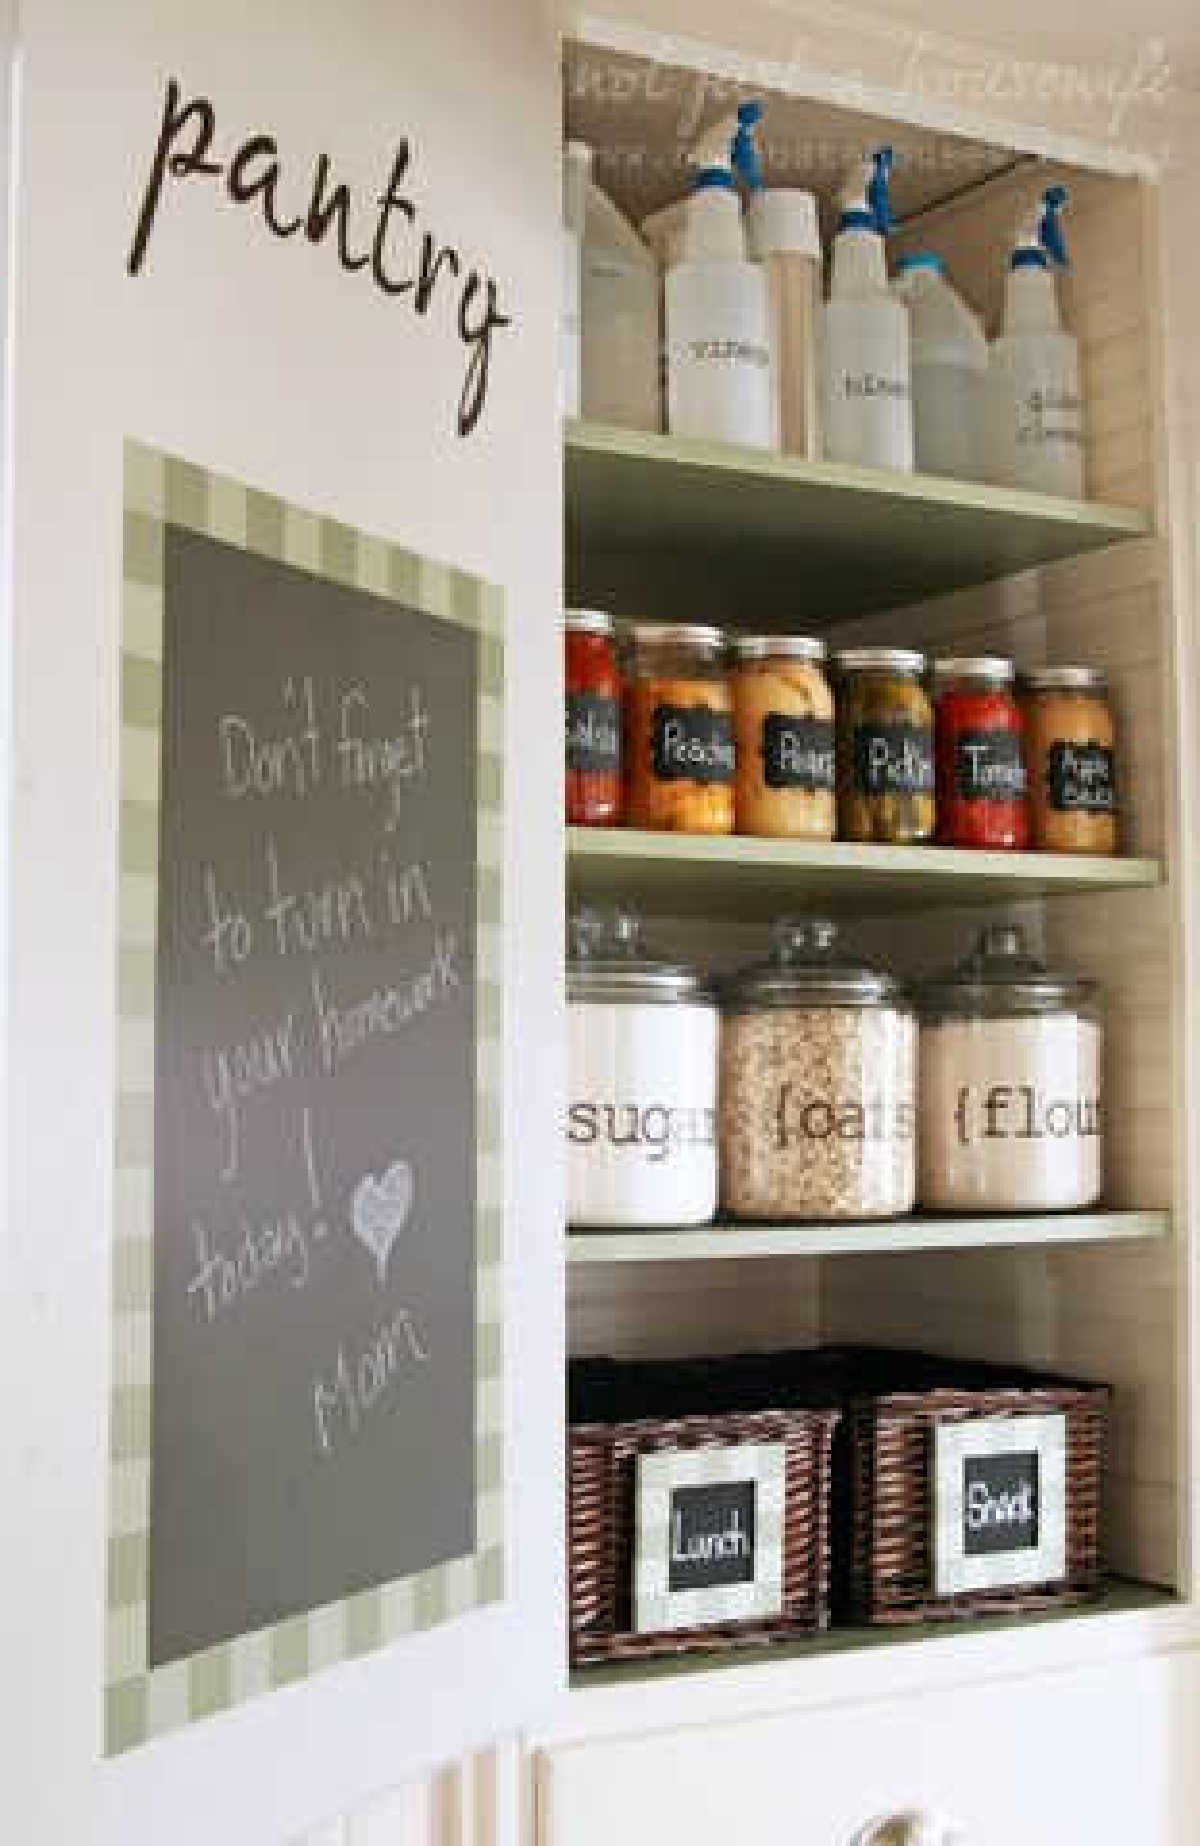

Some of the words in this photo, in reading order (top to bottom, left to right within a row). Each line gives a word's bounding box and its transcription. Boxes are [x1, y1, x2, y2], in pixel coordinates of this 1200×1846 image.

[127, 74, 512, 437] pantry
[216, 676, 322, 798] Don't
[334, 676, 430, 832] forget
[202, 861, 252, 970] to
[264, 832, 370, 954] turn
[377, 848, 433, 922] in
[208, 1012, 296, 1180] your
[313, 934, 460, 1076] homework
[312, 1306, 430, 1457] Mom
[671, 1507, 749, 1562] Lunch
